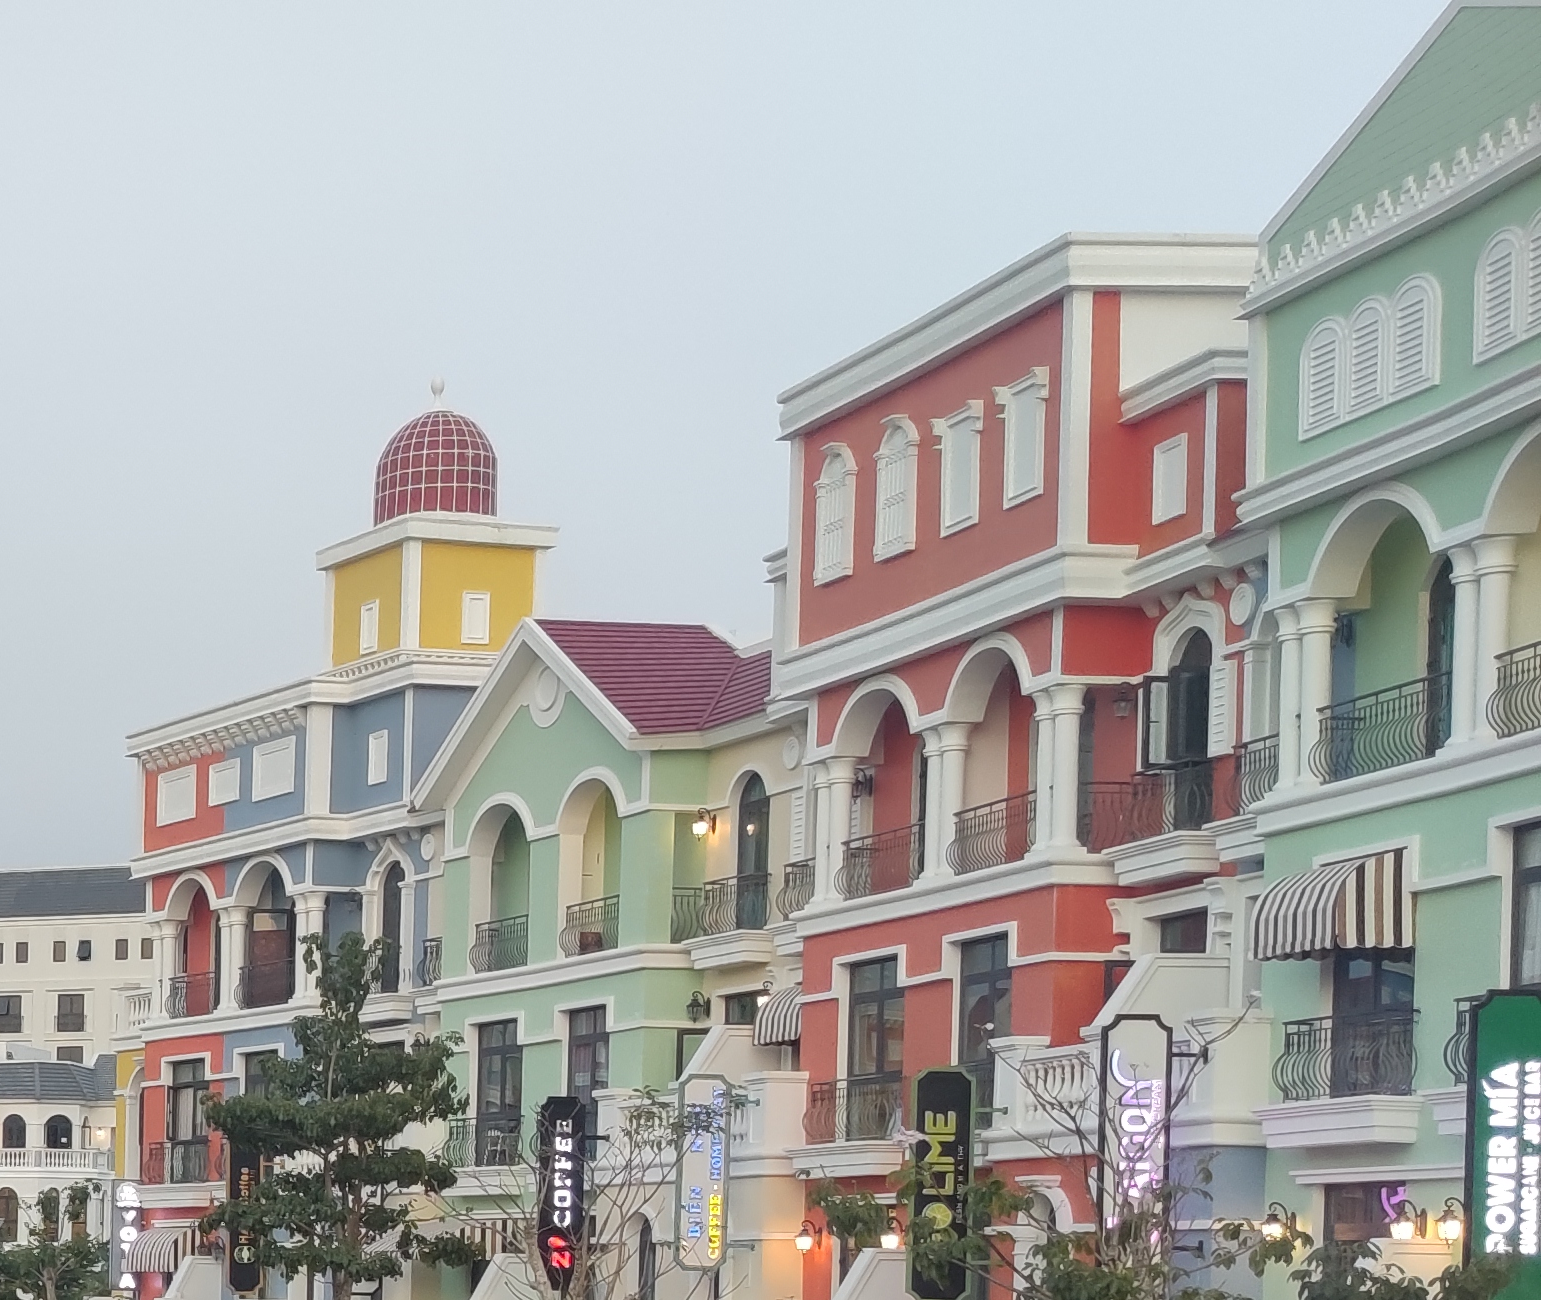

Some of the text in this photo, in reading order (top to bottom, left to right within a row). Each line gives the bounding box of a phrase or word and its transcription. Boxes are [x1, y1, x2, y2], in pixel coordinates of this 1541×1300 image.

[553, 1118, 573, 1229] COFFEE
[921, 1110, 958, 1196] LIME
[1485, 1133, 1517, 1255] POWER
